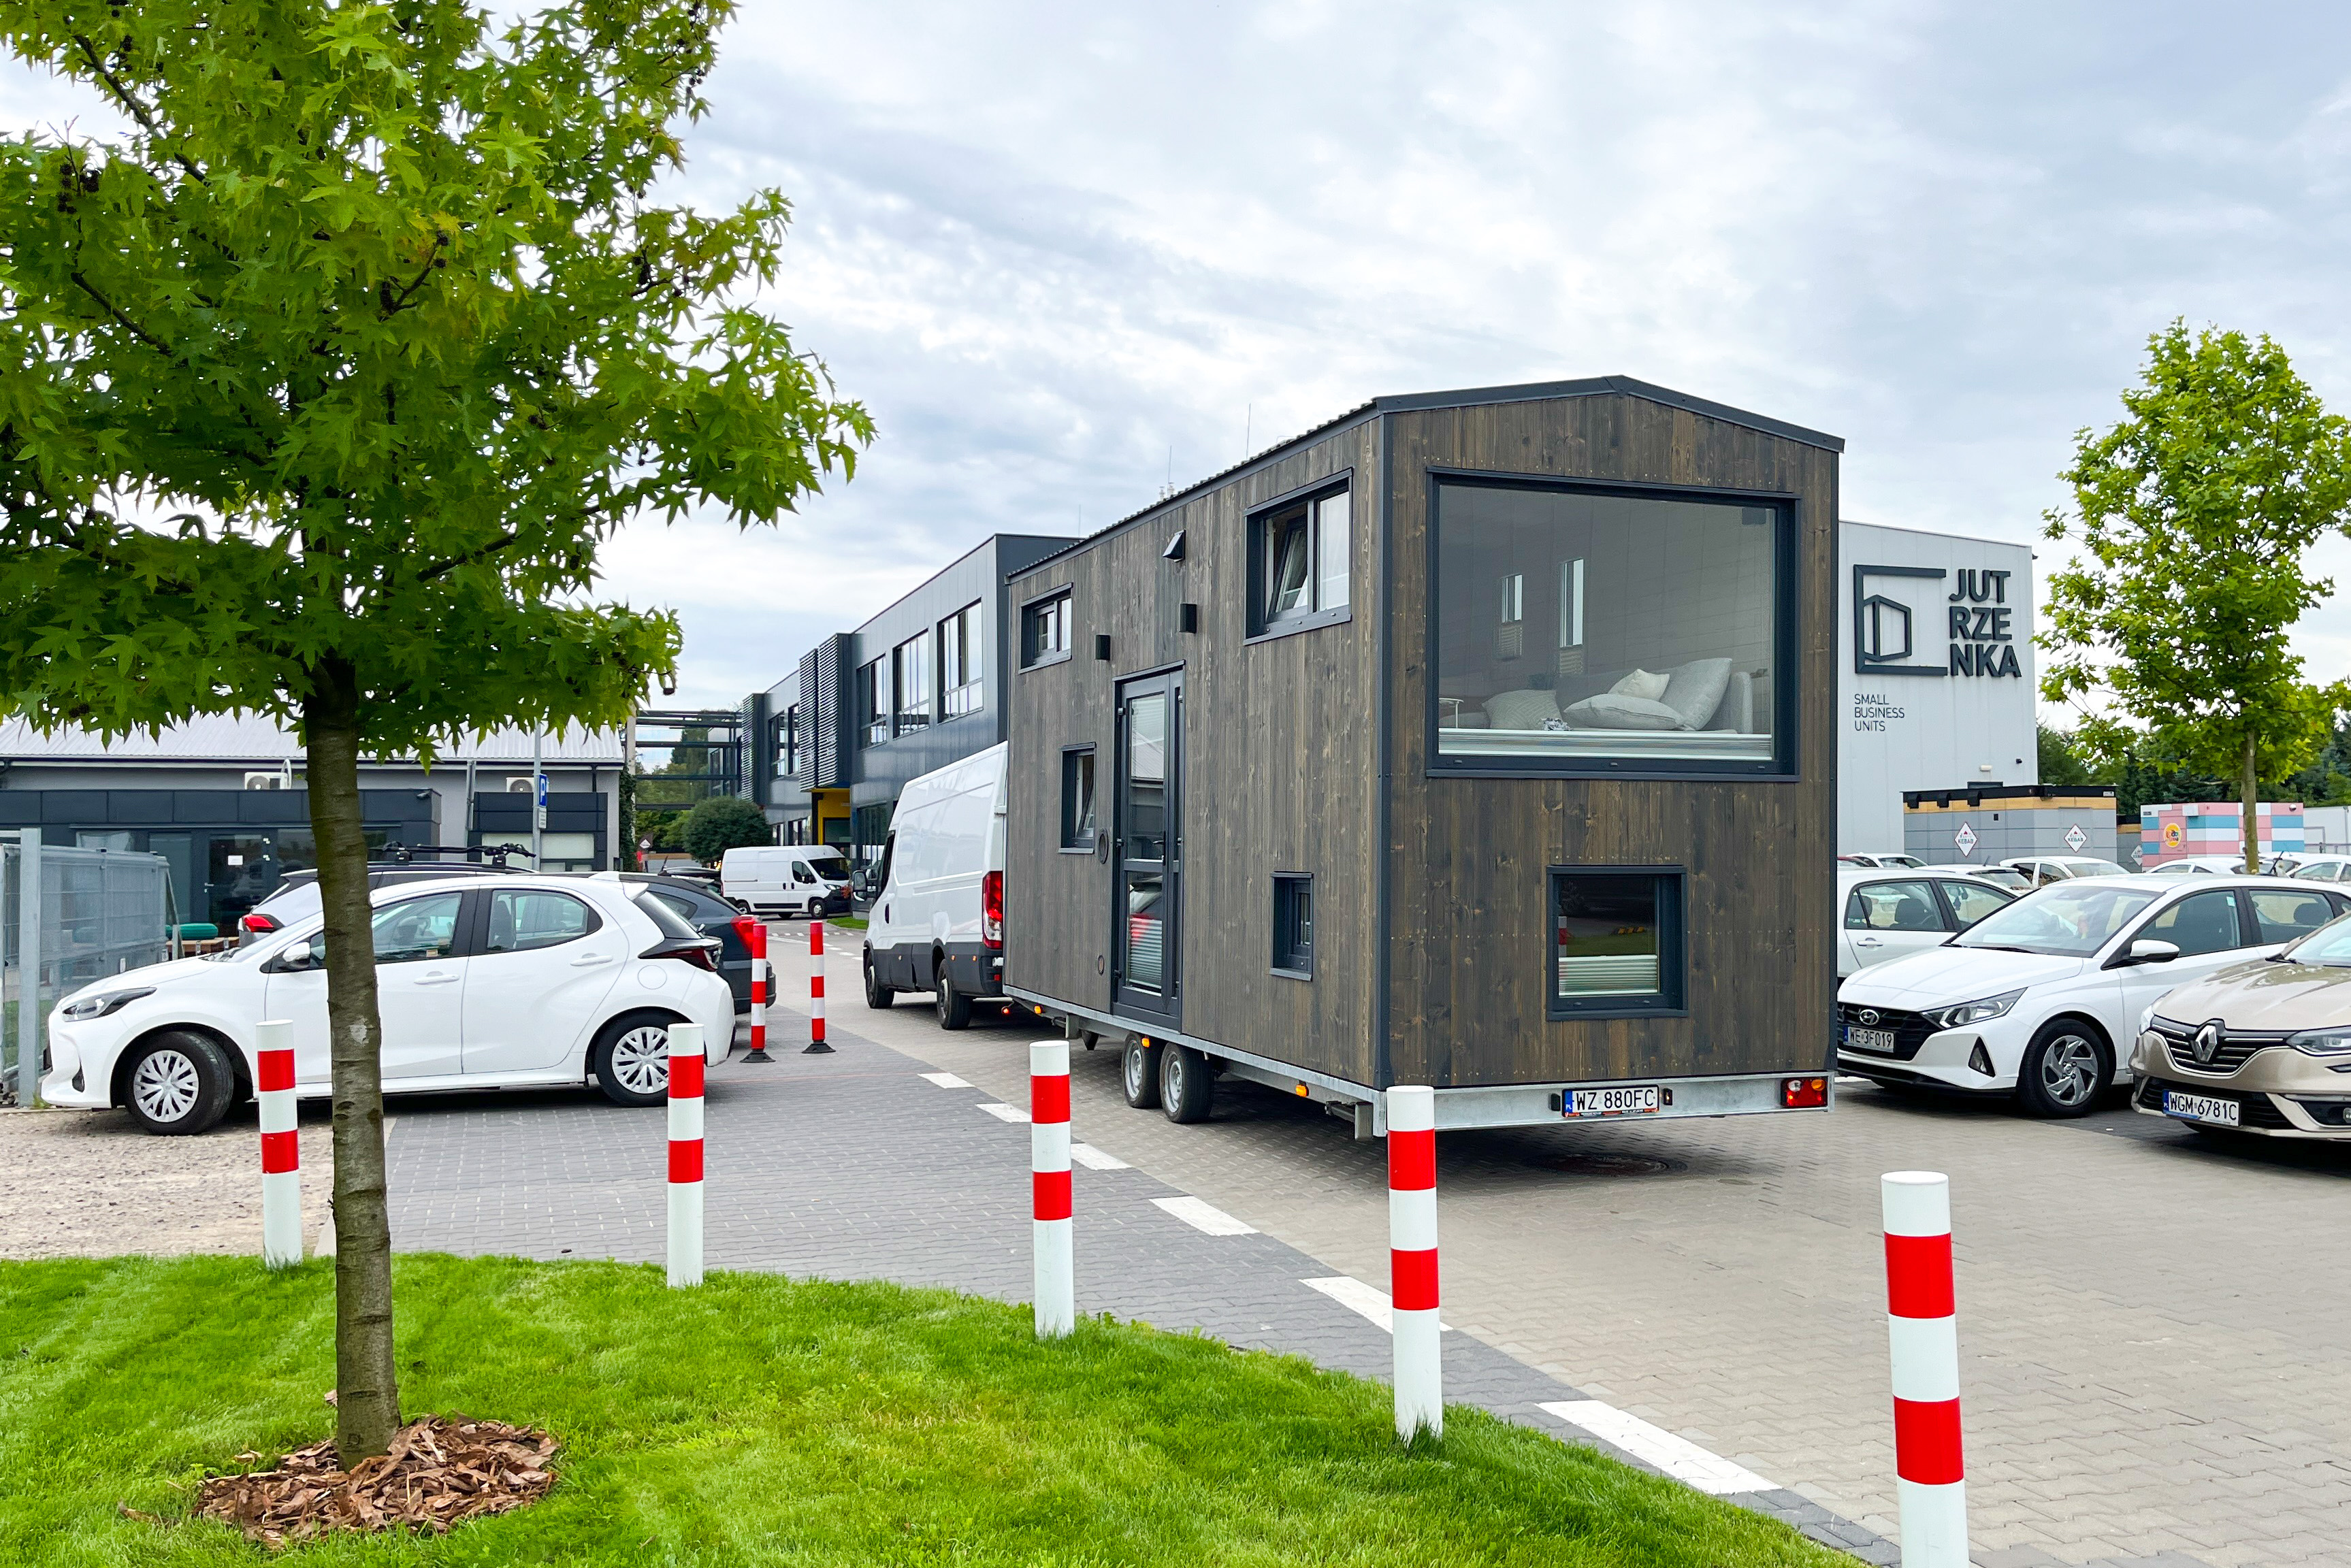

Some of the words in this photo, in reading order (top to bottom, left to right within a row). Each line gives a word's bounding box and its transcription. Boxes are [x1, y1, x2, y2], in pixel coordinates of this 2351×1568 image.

[1948, 568, 2011, 604] JUT
[1949, 606, 2013, 640] RZE
[1950, 643, 2022, 678] NKA
[1854, 693, 1890, 705] SMALL
[1854, 706, 1905, 719] BUSINESS
[1854, 720, 1886, 732] UNITS
[540, 778, 545, 802] P
[1850, 1029, 1861, 1043] WE
[1864, 1030, 1893, 1048] 3F019
[1576, 1092, 1597, 1110] WZ
[1604, 1089, 1654, 1109] 880FC
[2170, 1094, 2193, 1113] WGM
[2197, 1098, 2237, 1121] 6781C
